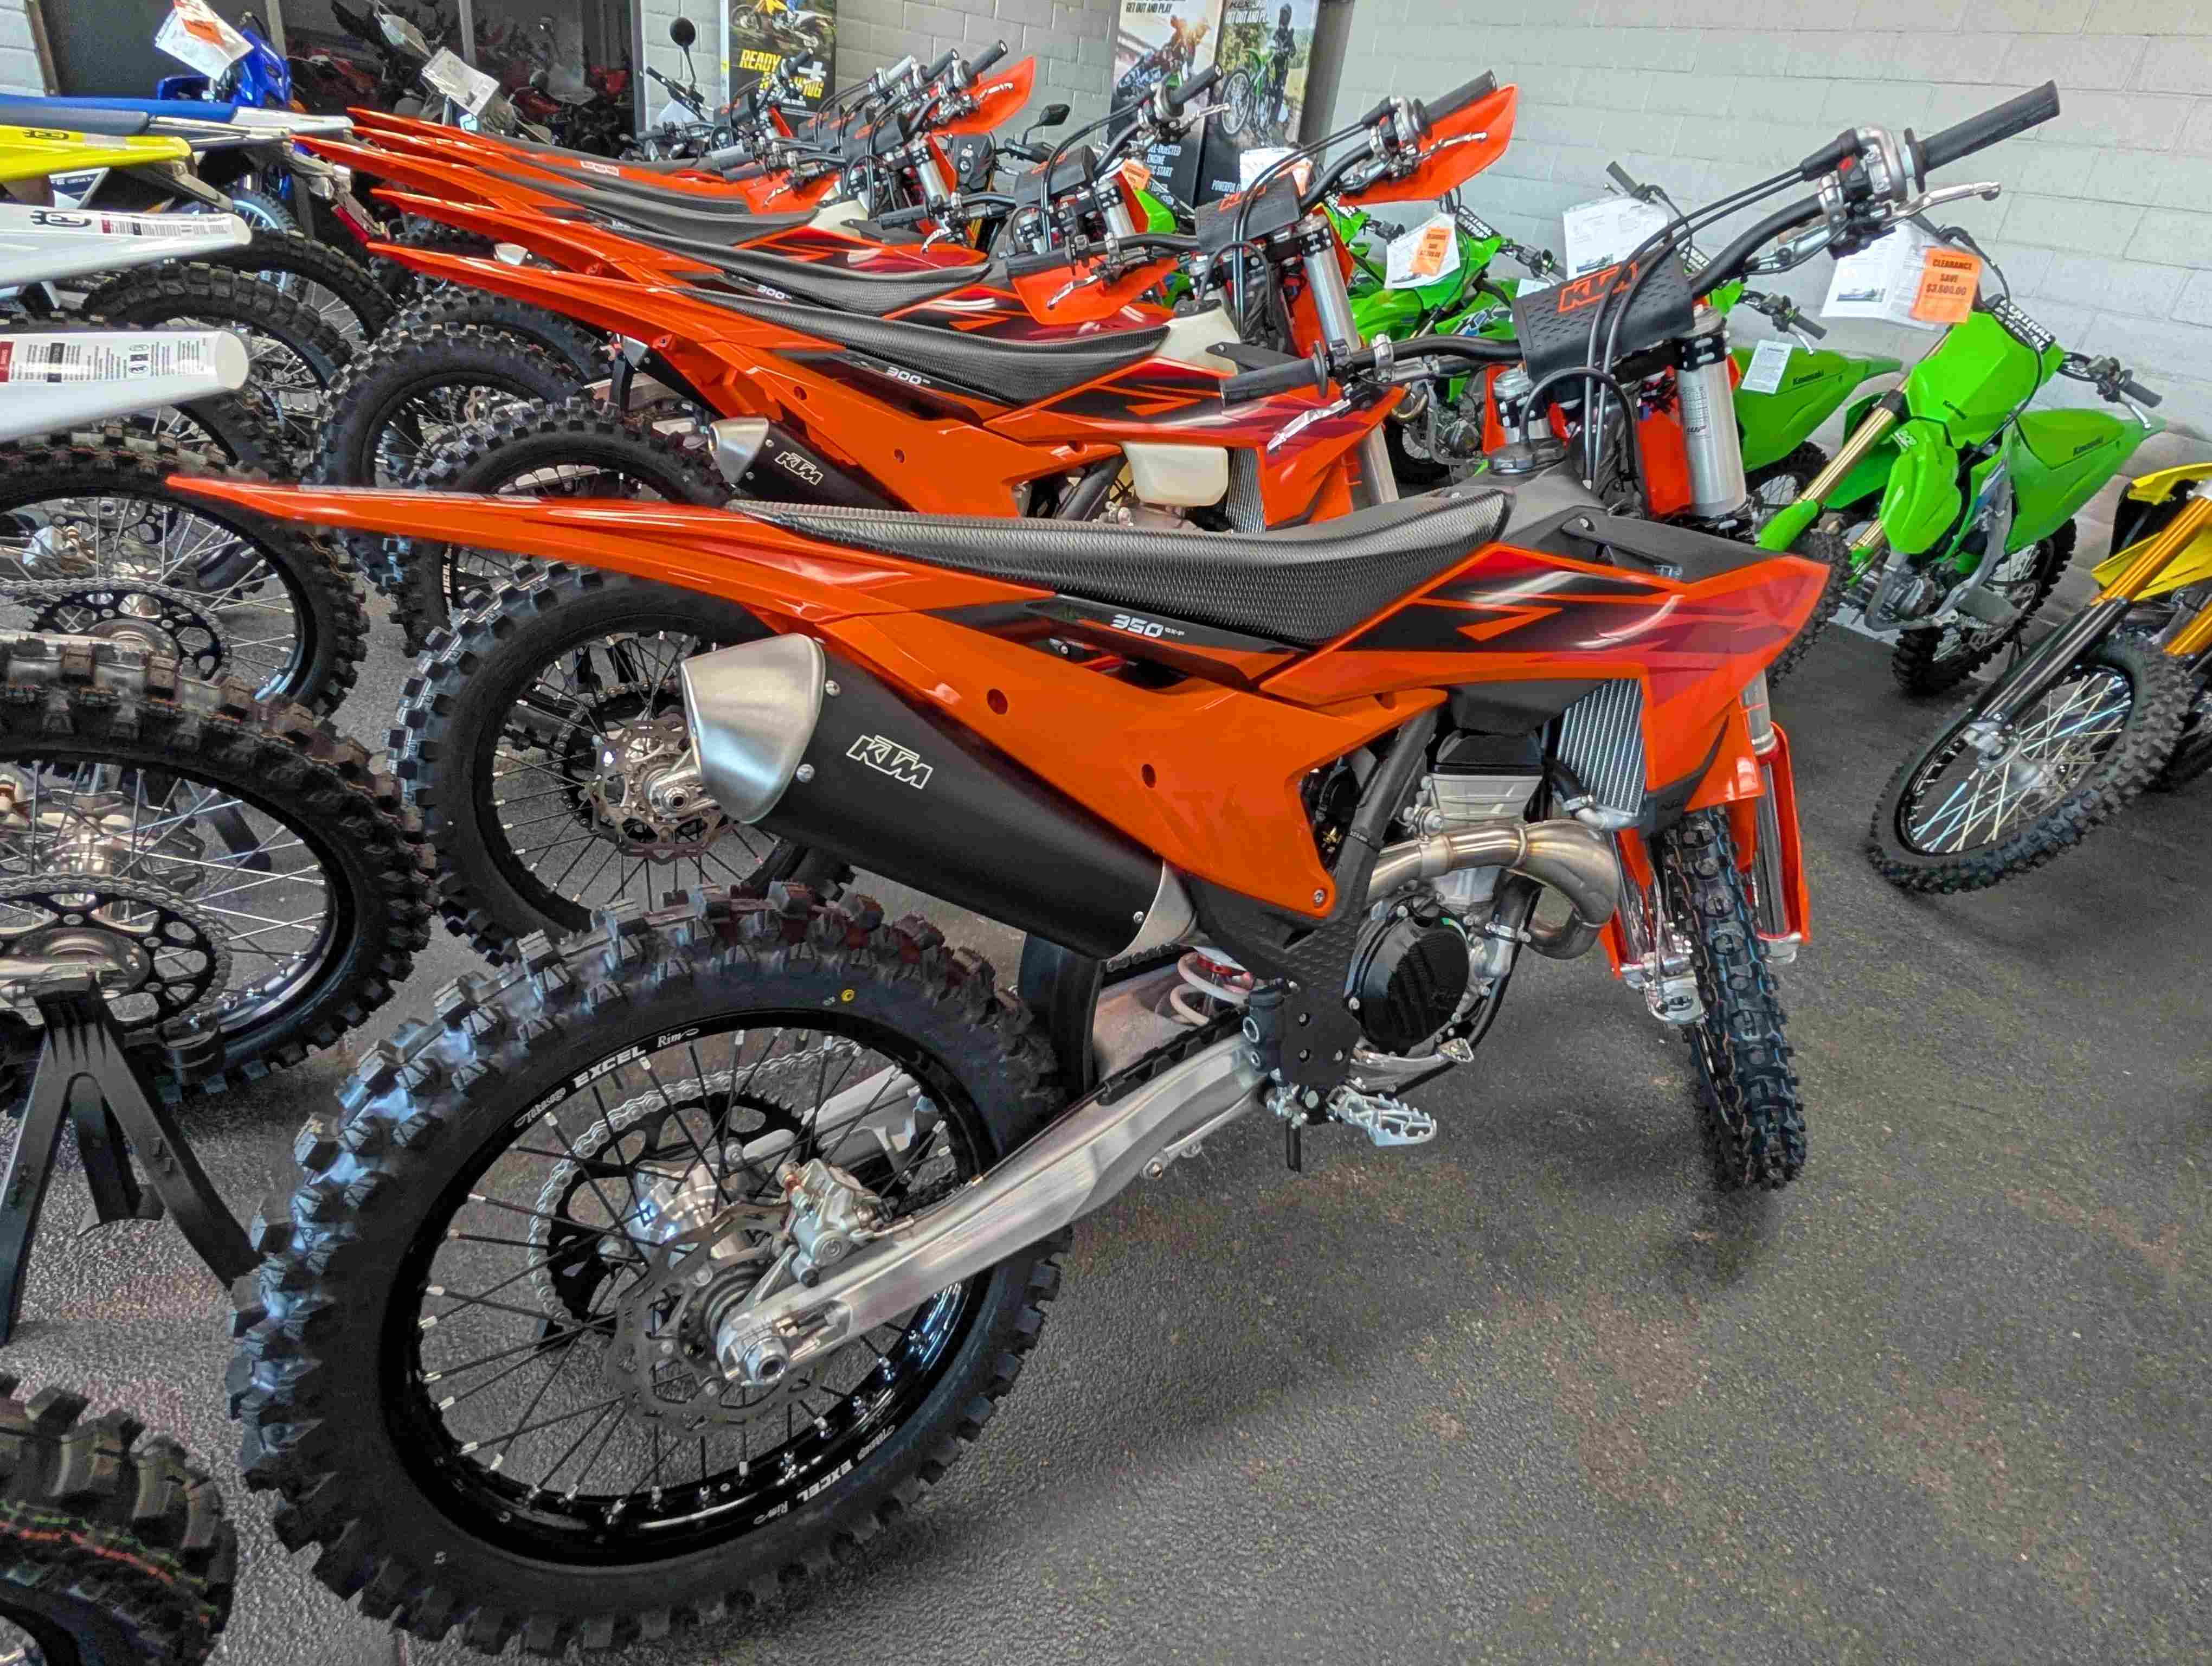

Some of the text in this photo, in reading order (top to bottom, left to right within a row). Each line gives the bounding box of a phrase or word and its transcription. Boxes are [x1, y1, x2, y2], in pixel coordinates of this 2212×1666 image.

[1136, 3, 1147, 13] OUT
[1146, 3, 1159, 13] AND
[1158, 3, 1172, 13] PLAY
[739, 49, 781, 73] READY
[1932, 259, 1972, 271] CLEARANCE
[1940, 273, 1958, 283] SAVE
[885, 366, 922, 385] 300
[775, 451, 824, 485] KTM
[1111, 613, 1164, 638] 350
[846, 734, 934, 790] KTM
[573, 1046, 647, 1088] EXCEL
[657, 1028, 694, 1048] Rim
[796, 1458, 854, 1502] EXCEL
